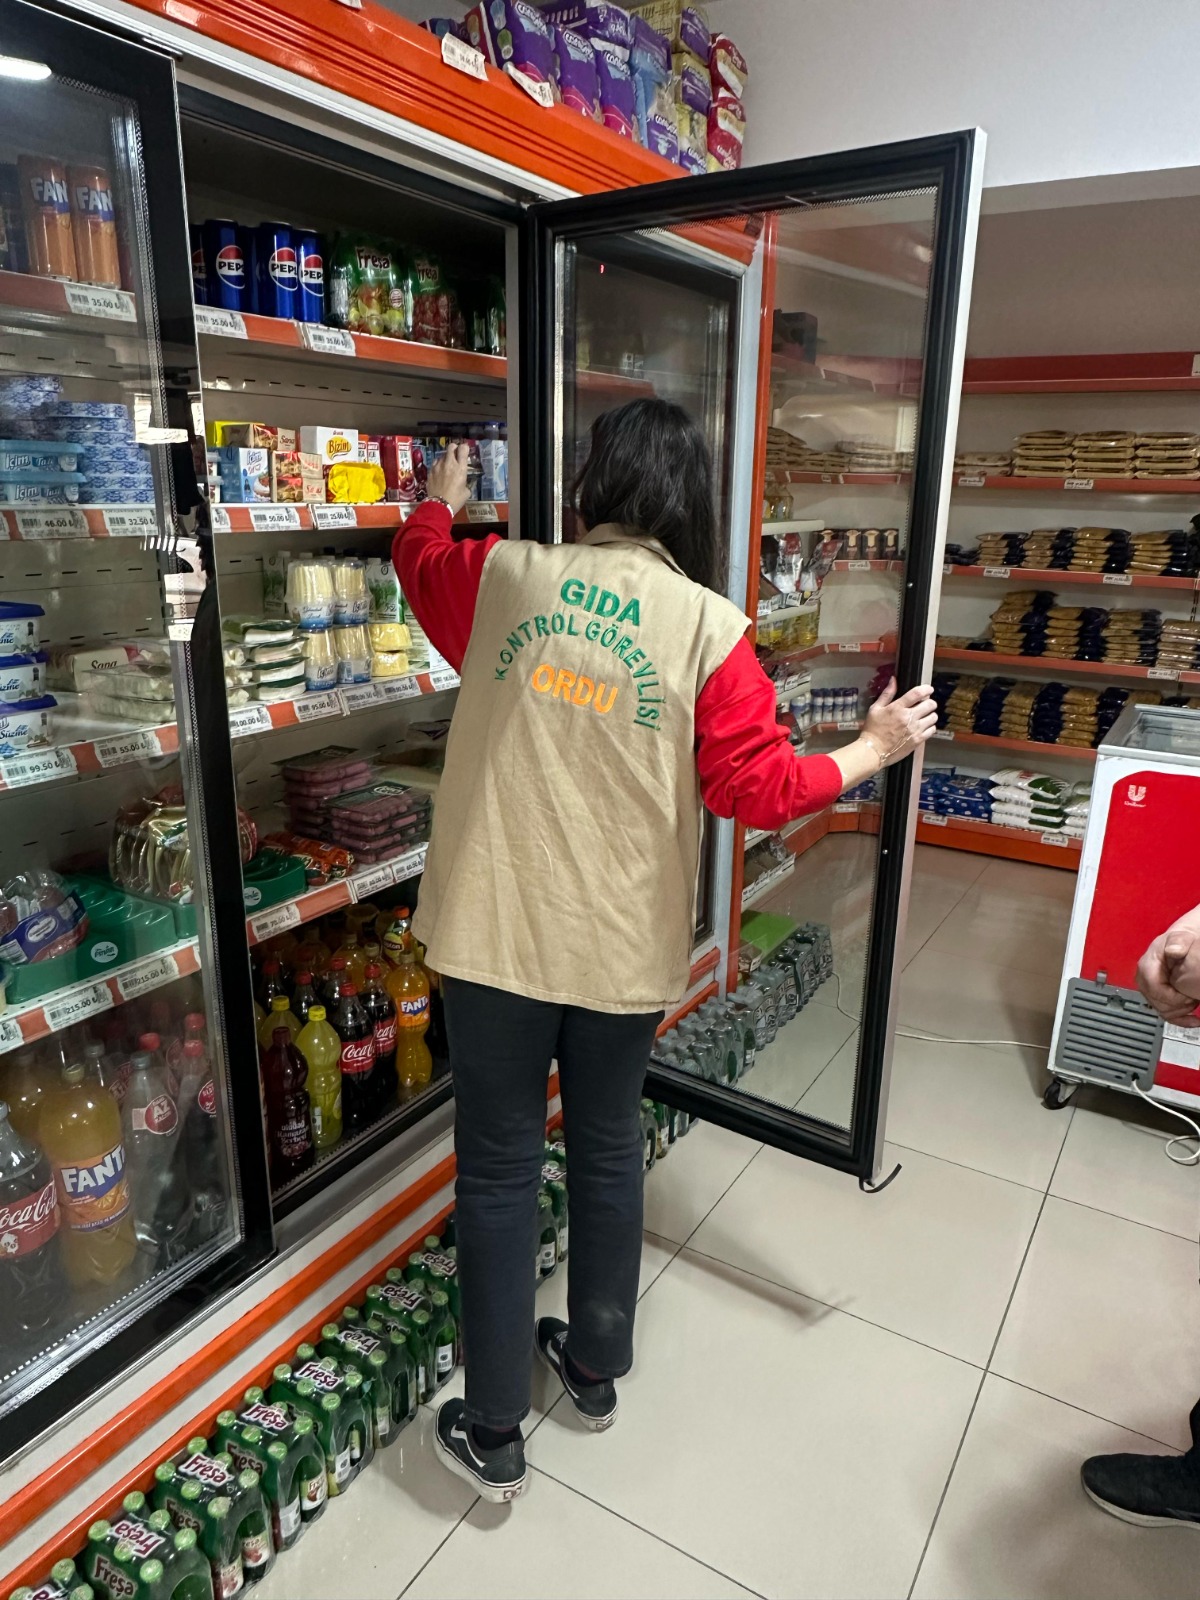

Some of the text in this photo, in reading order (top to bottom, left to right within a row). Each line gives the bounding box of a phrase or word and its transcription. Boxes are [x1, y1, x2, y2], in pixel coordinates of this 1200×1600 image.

[30, 177, 68, 203] FAN
[77, 186, 113, 212] FAN
[218, 260, 245, 271] PEP
[271, 262, 297, 275] PEP
[301, 269, 323, 280] PEP
[328, 438, 351, 454] Bizim
[560, 578, 640, 627] GIDA
[494, 612, 667, 731] KONTROL GÖREVLİSİ
[531, 663, 619, 715] ORDU
[29, 762, 53, 774] 99.50
[400, 995, 429, 1013] FANT
[61, 1144, 125, 1193] FANT
[300, 1363, 340, 1389] Freşa
[245, 1404, 287, 1429] Freşa
[184, 1454, 227, 1484] Freşa
[115, 1521, 161, 1556] Freşa
[94, 1556, 134, 1598] Freşa
